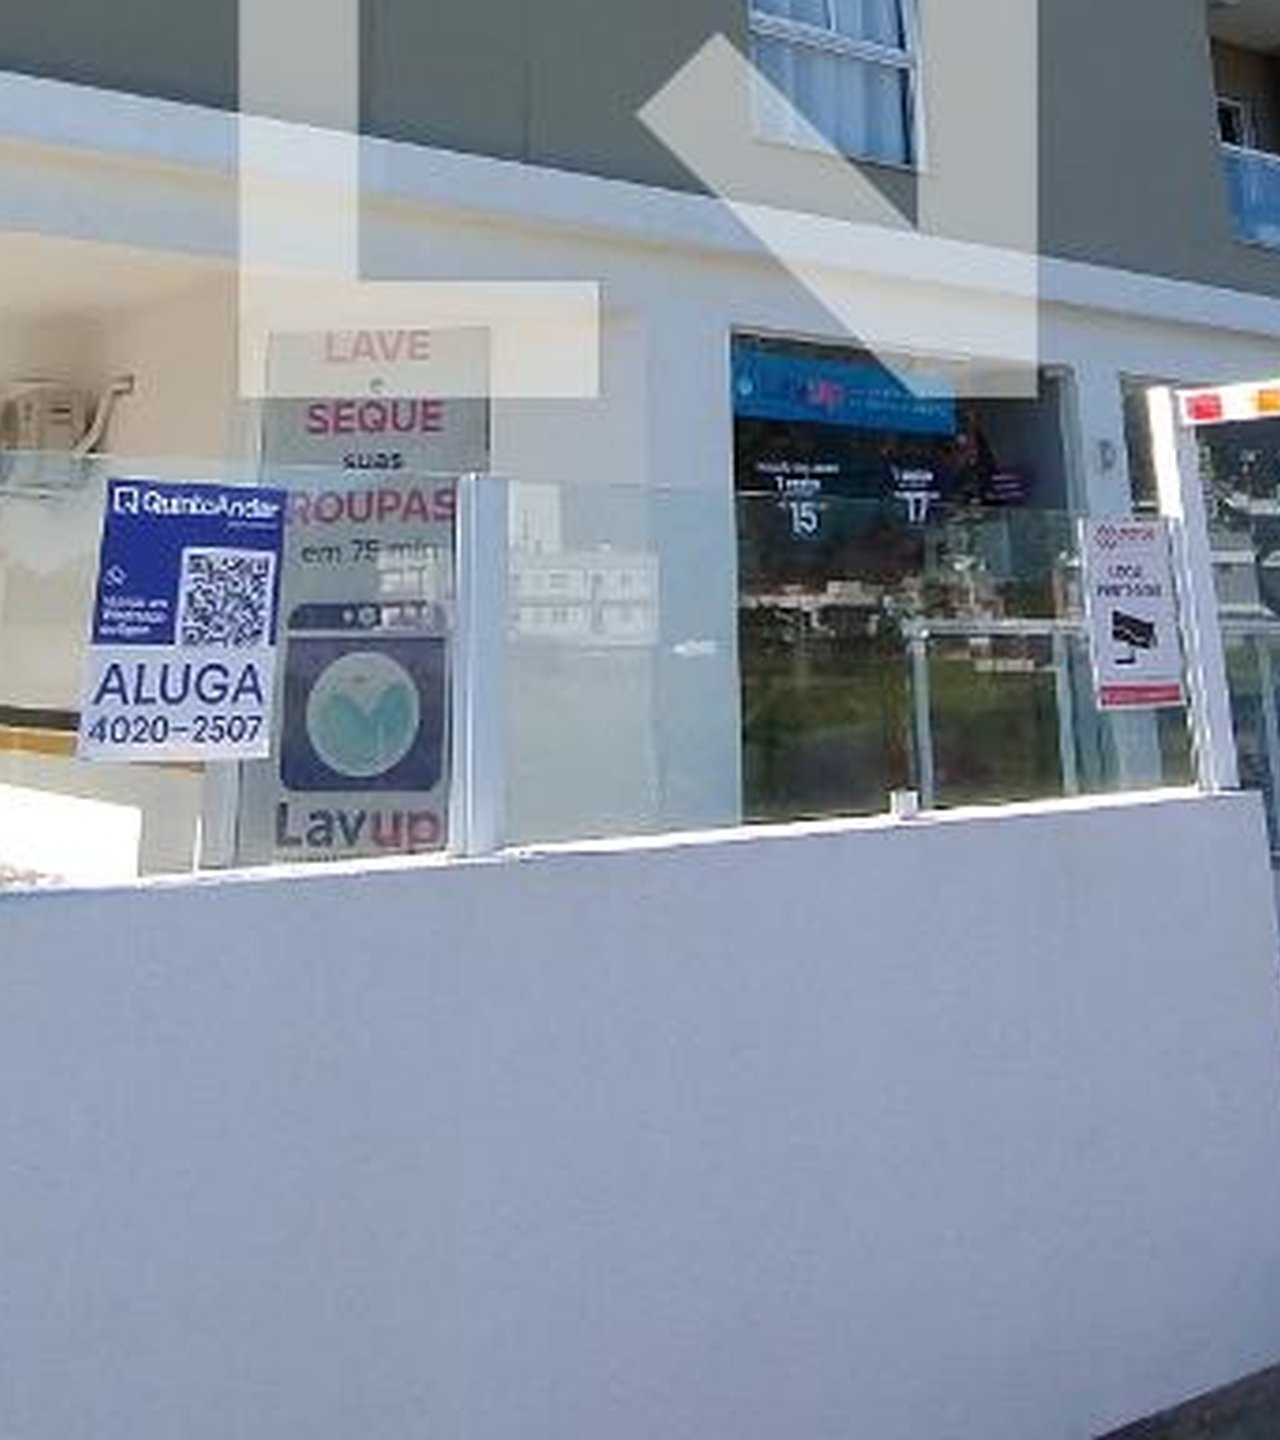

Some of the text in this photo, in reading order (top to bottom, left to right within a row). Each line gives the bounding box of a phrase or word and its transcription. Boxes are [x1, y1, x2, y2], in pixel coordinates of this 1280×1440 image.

[325, 329, 431, 362] LAVE
[306, 400, 445, 435] SEQUE
[342, 452, 404, 470] suas
[286, 487, 456, 525] ROUPAS
[301, 546, 342, 564] em
[92, 663, 263, 705] ALUGA
[87, 715, 263, 744] 4020-2507
[276, 801, 441, 852] Lavup
